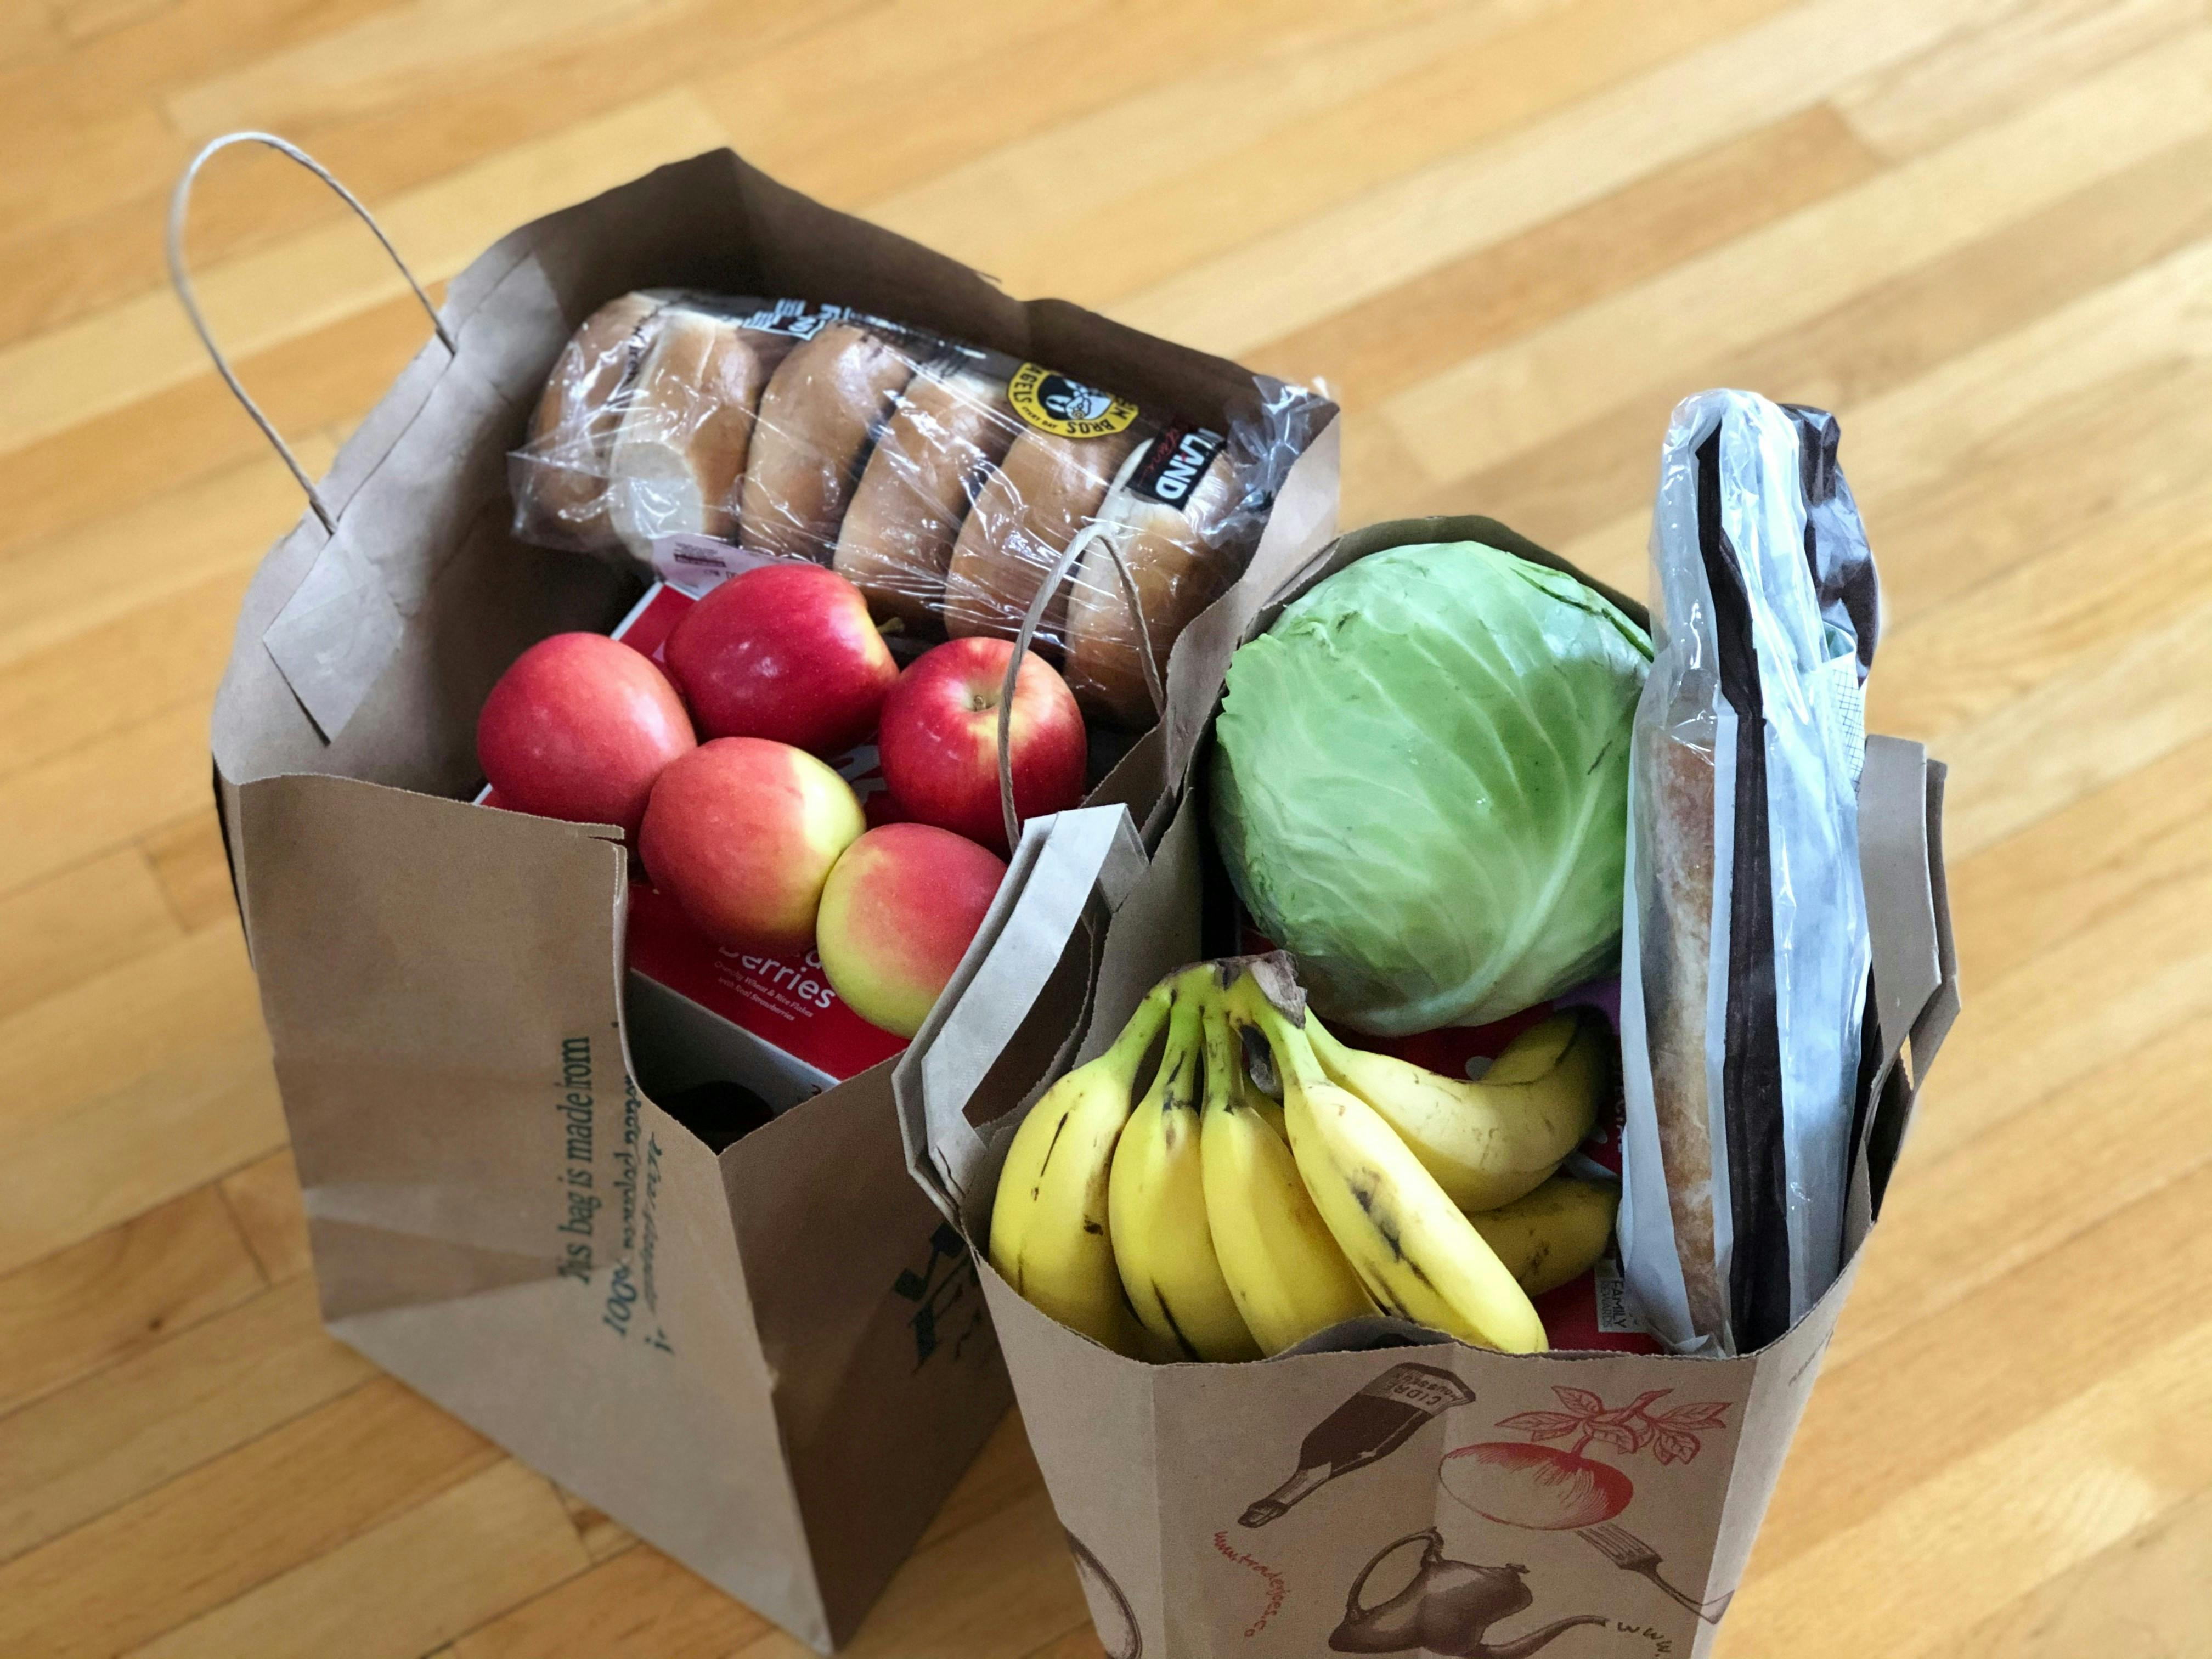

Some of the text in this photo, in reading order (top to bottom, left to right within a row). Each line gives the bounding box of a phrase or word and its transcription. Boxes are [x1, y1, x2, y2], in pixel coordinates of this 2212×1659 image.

[1013, 364, 1043, 403] AGELS
[1066, 418, 1116, 435] BROS
[736, 985, 753, 998] Real
[751, 993, 795, 1022] Strawberries
[744, 976, 769, 994] Wheat
[768, 989, 775, 997] &
[775, 993, 791, 1006] Rice
[790, 1000, 814, 1018] Flakes
[556, 1092, 594, 1163] made
[557, 1167, 593, 1189] is
[557, 1190, 602, 1238] bag
[557, 1243, 592, 1284] Tis
[1611, 1281, 1627, 1328] FAMILY
